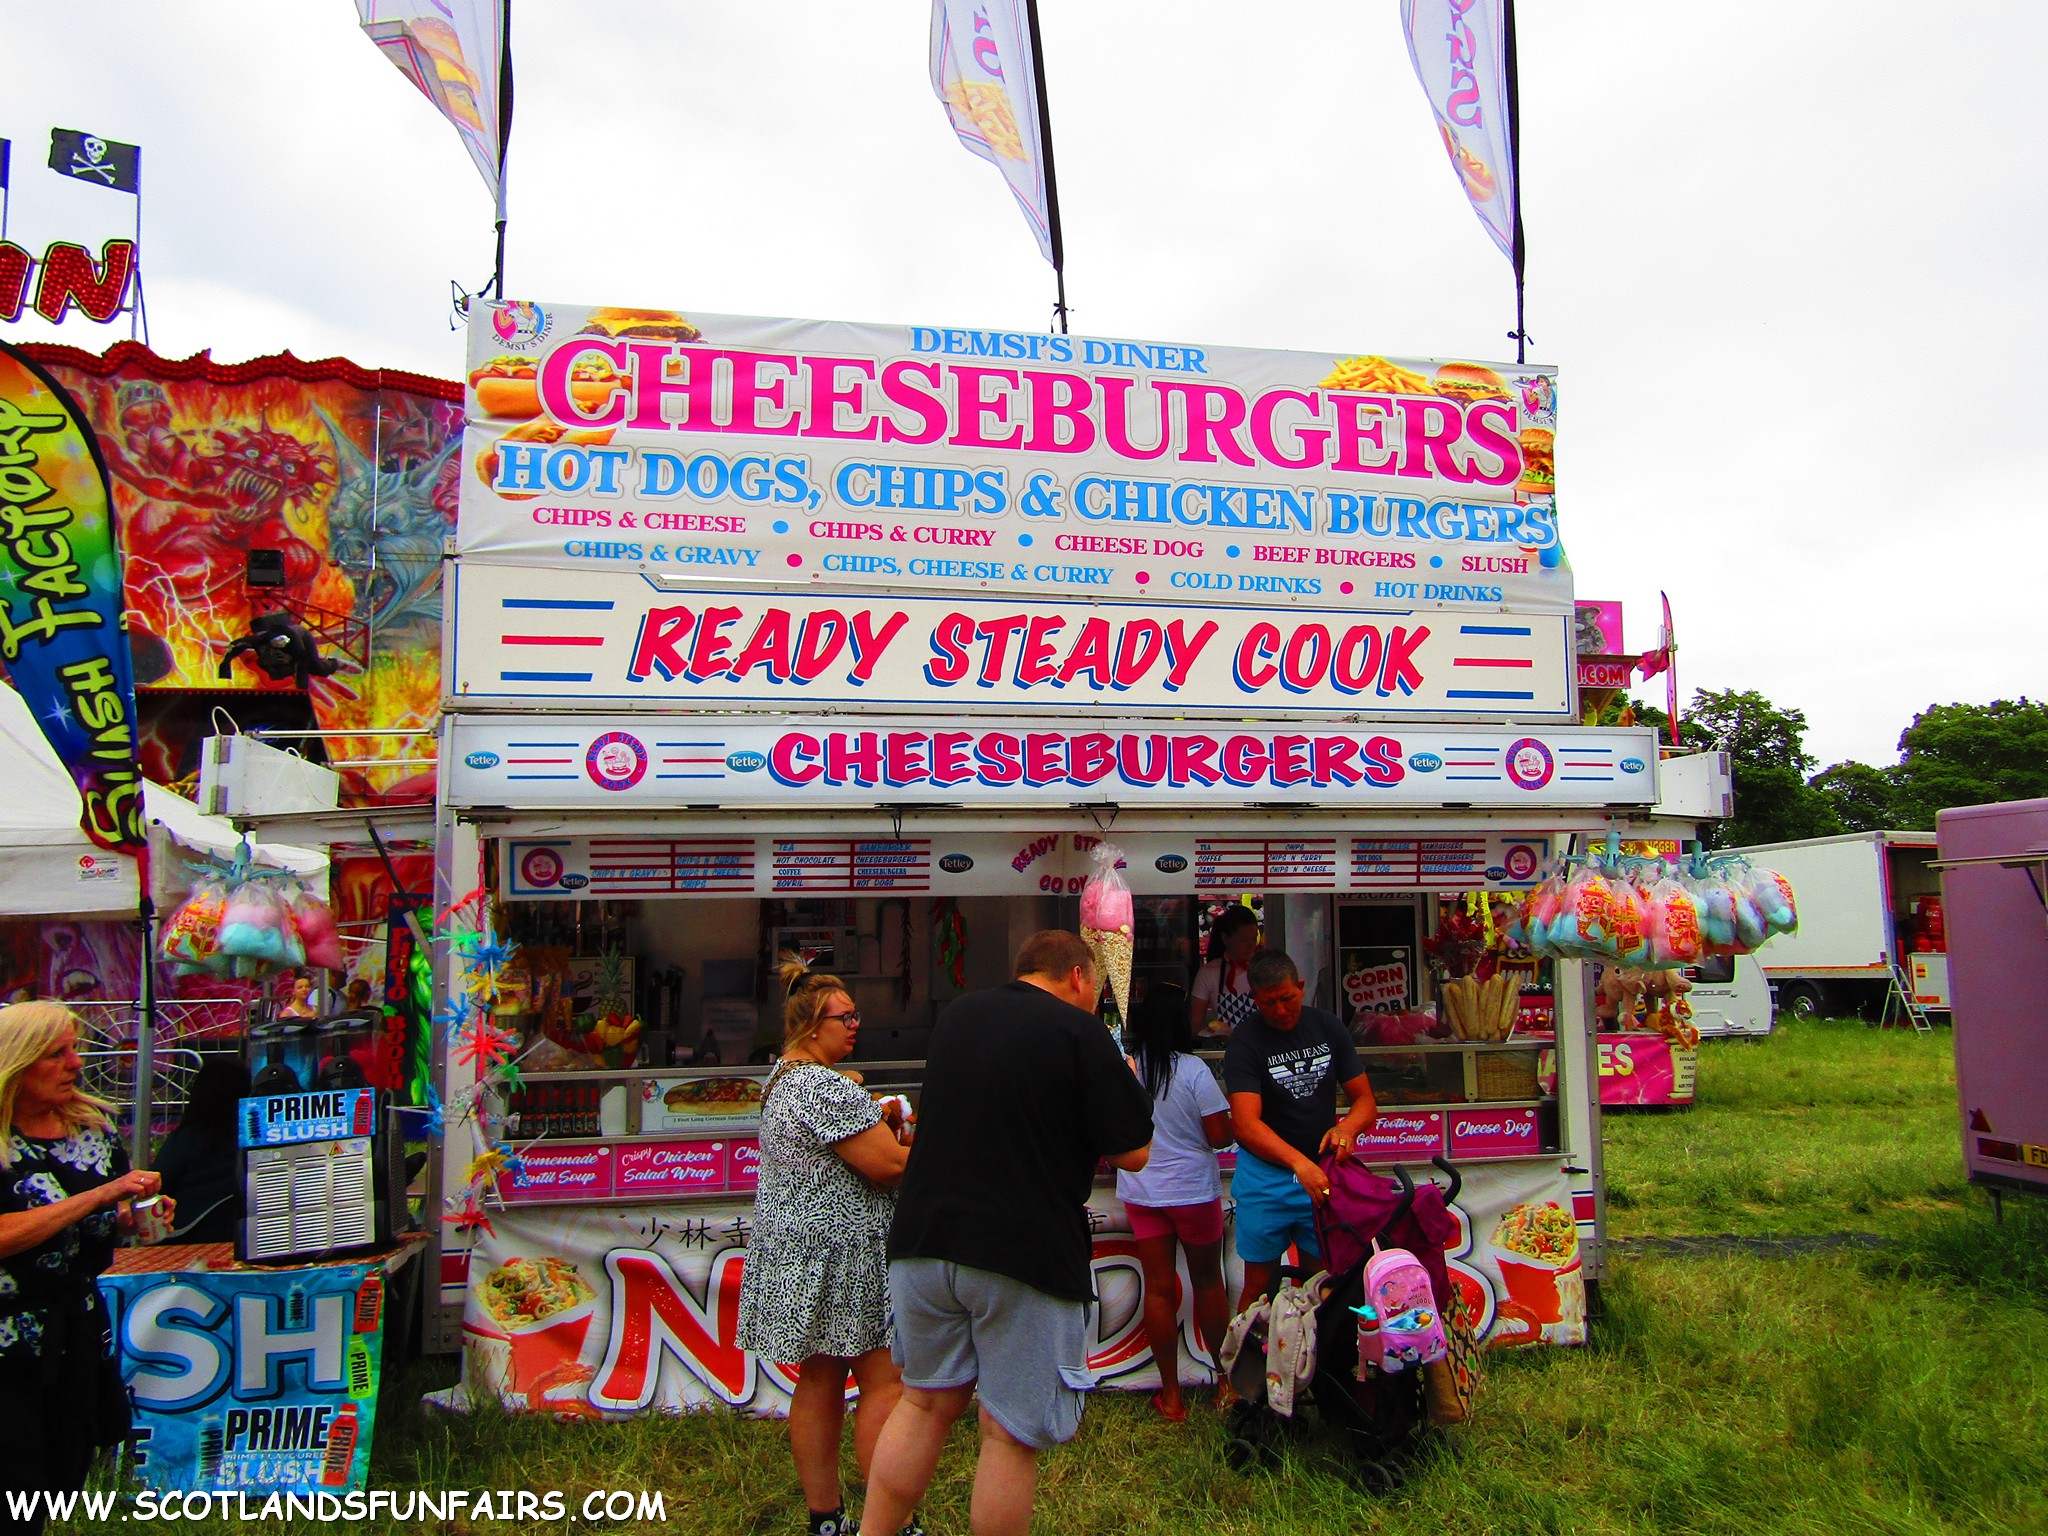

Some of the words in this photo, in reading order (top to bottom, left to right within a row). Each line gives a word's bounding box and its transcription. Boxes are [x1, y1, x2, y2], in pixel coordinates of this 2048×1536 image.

[911, 327, 1073, 362] DEMSI'S
[1082, 339, 1208, 373] DINER
[542, 338, 1522, 487] CHEESEBURGERS
[497, 445, 628, 494] HOT
[641, 453, 820, 511] DOGS,
[838, 462, 1006, 515] CHIPS
[1021, 473, 1063, 518] &
[1075, 477, 1313, 531] CHICKEN
[1327, 493, 1557, 546] BURGERS
[533, 507, 612, 528] CHIPS
[618, 511, 639, 529] &
[645, 512, 746, 534] CHEESE
[809, 521, 883, 542] CHIPS
[888, 524, 908, 543] &
[913, 526, 996, 547] CURRY
[564, 540, 643, 561] CHIPS
[649, 544, 669, 562] &
[674, 545, 760, 567] GRAVY
[1054, 534, 1147, 556] CHEESE
[1154, 539, 1203, 558] DOG
[1253, 545, 1310, 563] BEEF
[1315, 549, 1416, 569] BURGERS
[1462, 554, 1529, 574] SLUSH
[823, 554, 902, 577] CHIPS,
[909, 557, 1005, 579] CHEESE
[1010, 564, 1029, 582] &
[1034, 565, 1114, 586] CURRY
[1171, 572, 1232, 591] COLD
[1238, 574, 1321, 596] DRINKS
[1375, 582, 1418, 599] HOT
[1423, 583, 1502, 603] DRINKS
[627, 604, 909, 687] READY
[923, 612, 1218, 693] STEADY
[1233, 622, 1431, 696] COOK
[1577, 663, 1625, 686] .COM
[468, 755, 498, 767] Tetley
[729, 755, 764, 769] Tetley
[766, 732, 1406, 790] CHEESEBURGERS
[1411, 757, 1441, 770] Tetley
[1622, 761, 1644, 771] Tetley
[778, 844, 794, 852] TEA
[1012, 833, 1059, 873] READY
[676, 856, 700, 865] CHIPS
[794, 856, 836, 864] CHOCOLATE
[942, 858, 971, 869] Tetley
[1158, 859, 1186, 870] Tetley
[562, 877, 588, 887] Tetley
[591, 869, 615, 878] CHIPS
[629, 869, 657, 877] GRAVY
[676, 868, 700, 877] CHIPS
[713, 867, 741, 876] CHEESE
[1487, 869, 1507, 879] Tetley
[681, 880, 706, 888] CHIPS
[776, 879, 803, 887] BOVRIL
[856, 879, 869, 887] HOT
[386, 927, 412, 1000] PHOTO
[1346, 966, 1404, 989] CORN
[1352, 989, 1374, 1003] ON
[1377, 983, 1404, 998] THE
[1268, 1050, 1300, 1067] ARMANI
[1302, 1043, 1330, 1059] JEANS
[267, 1092, 346, 1124] PRIME
[266, 1122, 349, 1142] SLUSH
[1376, 1117, 1426, 1132] Footlong
[1455, 1120, 1501, 1137] Cheese
[1503, 1119, 1533, 1137] Dog
[1356, 1132, 1397, 1147] German
[1399, 1132, 1440, 1146] Sausage
[621, 1147, 652, 1166] Crispy
[652, 1149, 714, 1167] Chicken
[558, 1169, 597, 1185] Soup
[623, 1168, 669, 1183] Salad
[671, 1166, 716, 1182] Wrap
[358, 1287, 378, 1325] PRIME
[351, 1350, 368, 1392] PRIME
[224, 1406, 333, 1451] PRIME
[216, 1459, 323, 1486] SLUSH
